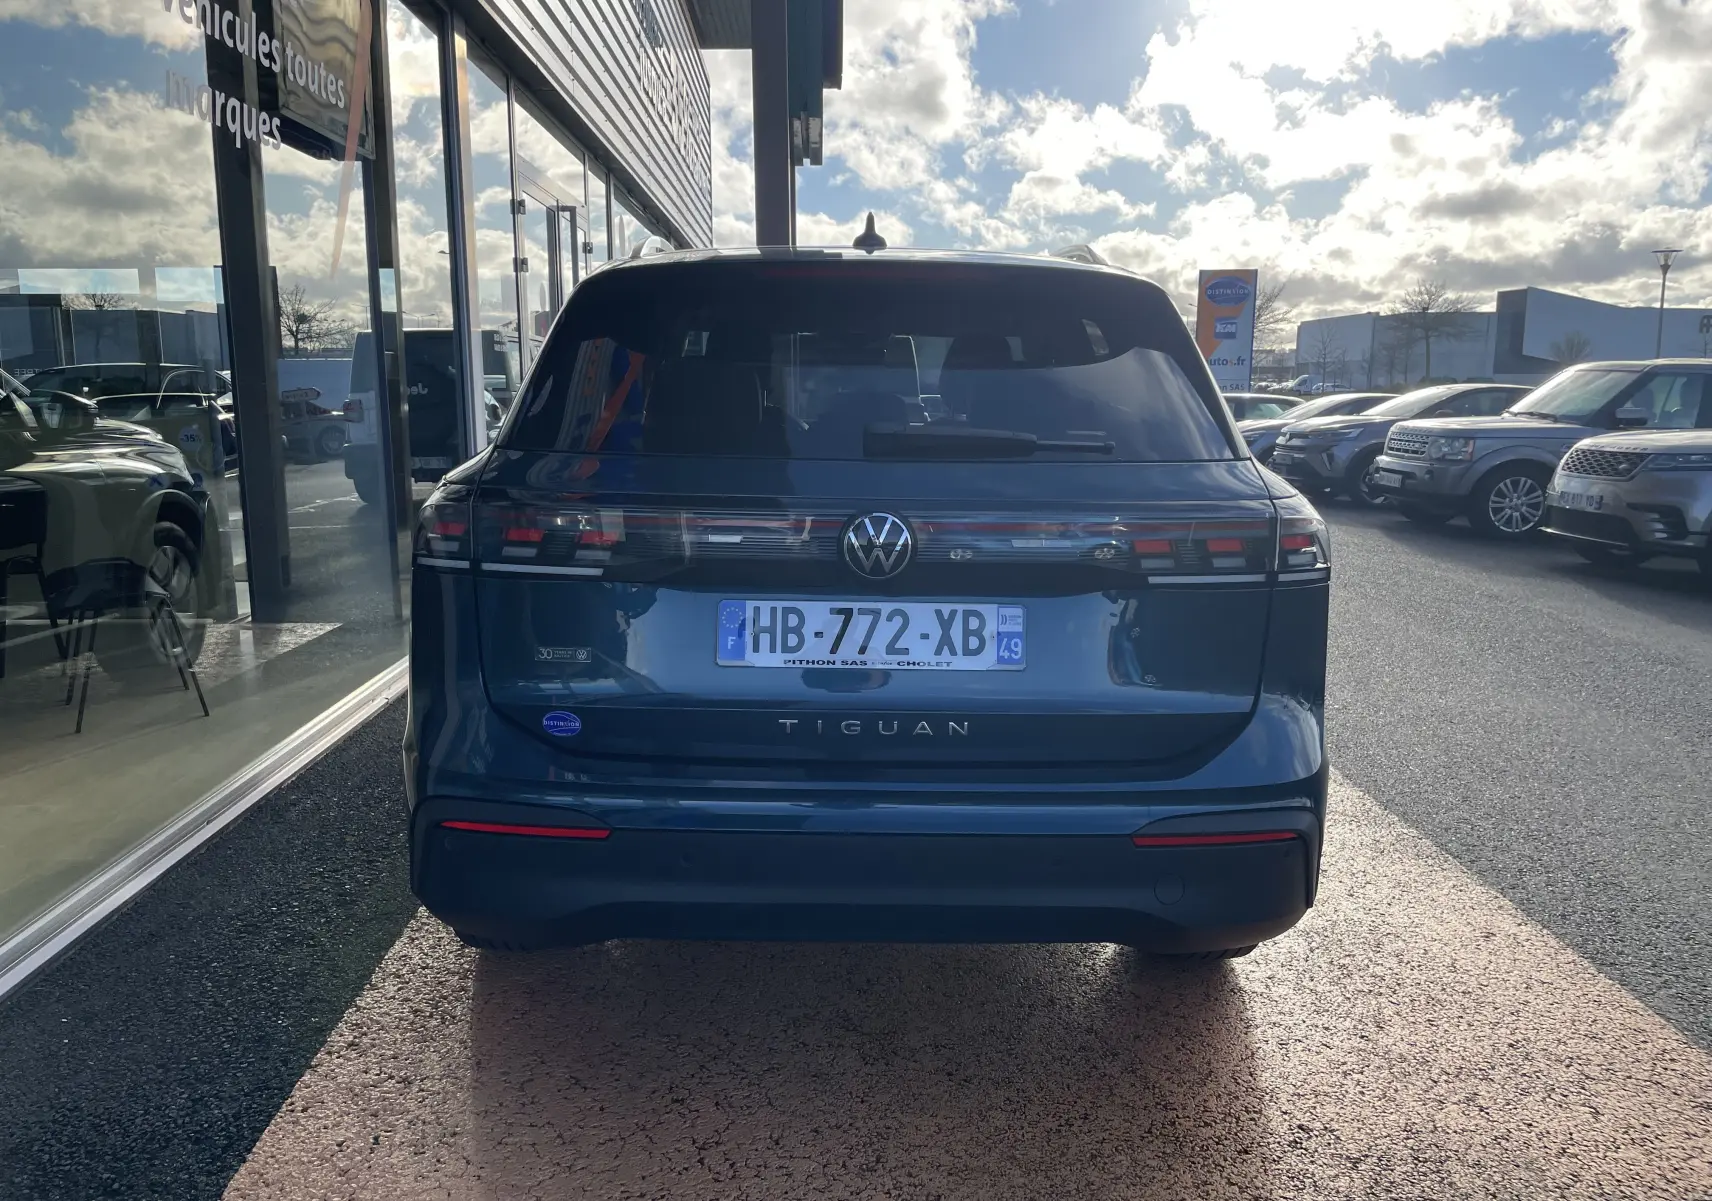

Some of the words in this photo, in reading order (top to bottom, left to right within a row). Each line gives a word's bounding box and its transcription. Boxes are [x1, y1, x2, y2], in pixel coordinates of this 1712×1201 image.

[285, 42, 345, 109] toutes
[166, 70, 281, 150] marques
[1229, 383, 1245, 391] SAS
[752, 606, 987, 656] HB-772-XB
[727, 636, 736, 650] F
[998, 638, 1023, 659] 49
[538, 648, 553, 659] 30
[783, 659, 837, 667] PITHON
[840, 659, 868, 667] SAS
[896, 660, 952, 668] CHOLET
[778, 719, 969, 736] TIGUAN
